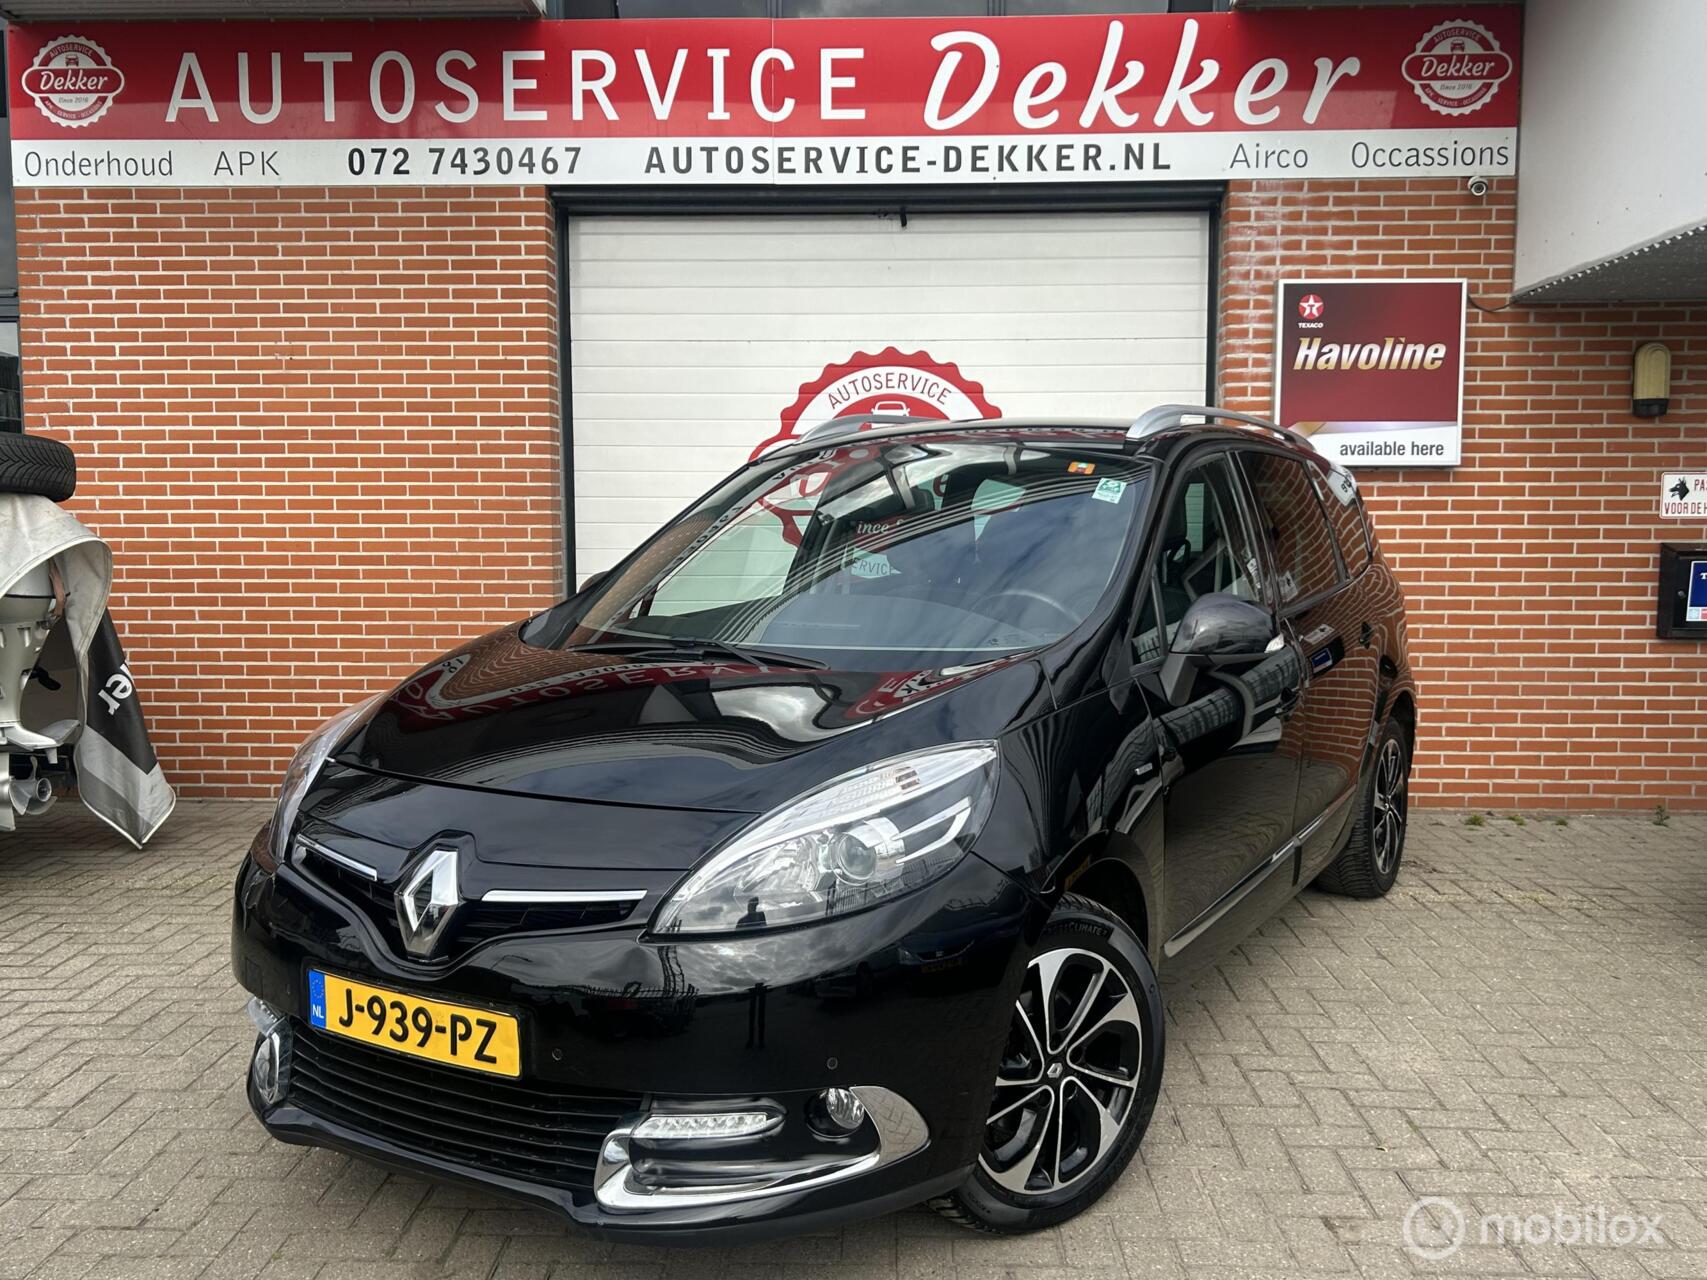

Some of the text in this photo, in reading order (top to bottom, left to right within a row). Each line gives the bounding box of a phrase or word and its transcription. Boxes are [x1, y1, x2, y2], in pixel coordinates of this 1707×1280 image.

[165, 18, 1361, 131] AUTOSERVICE Dekker
[1421, 54, 1495, 77] Dekker
[40, 69, 108, 90] Dekker
[24, 140, 1509, 178] Onderhoud APK 072 7430467 AUTOSERVICE-DEKKER.NL Airco Occassions
[1293, 337, 1447, 371] Havoline
[828, 372, 952, 410] AUTOSERVICE
[1339, 441, 1444, 456] available here
[1694, 479, 1707, 491] PA
[1664, 502, 1689, 515] VOOR
[857, 520, 889, 534] ince
[98, 664, 136, 716] er
[312, 1004, 324, 1019] NL
[338, 988, 497, 1064] J-939-PZ
